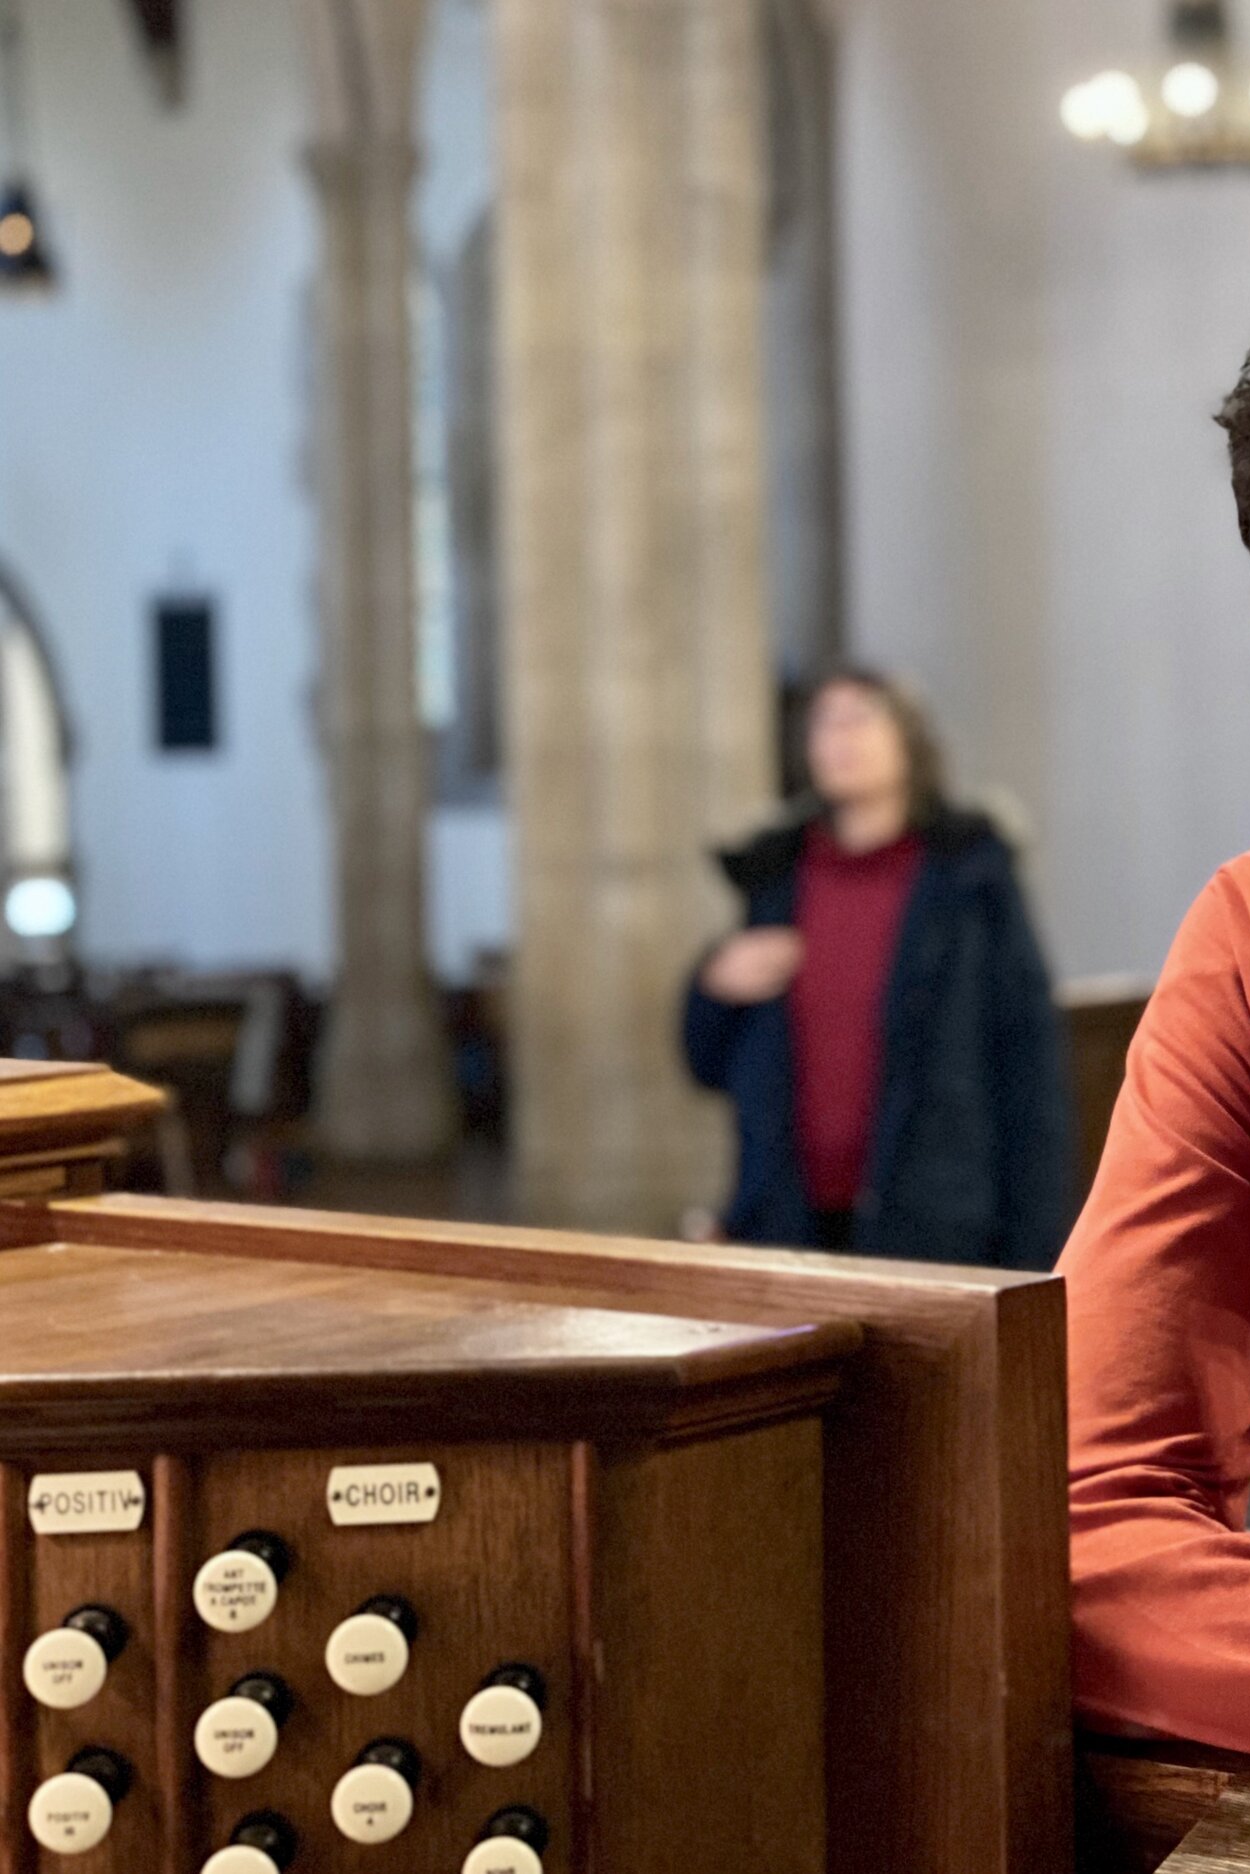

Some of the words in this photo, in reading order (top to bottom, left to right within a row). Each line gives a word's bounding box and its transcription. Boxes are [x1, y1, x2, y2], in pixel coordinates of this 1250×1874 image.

[345, 1482, 420, 1507] CHOIR
[38, 1489, 133, 1516] POSITIV
[344, 1652, 385, 1665] CHIMES
[42, 1660, 83, 1671] UNISON
[52, 1673, 73, 1685] OFF
[213, 1729, 255, 1739] UNISON
[468, 1722, 532, 1736] TREMULANT
[223, 1742, 244, 1754] OFF
[353, 1802, 387, 1813] CHOIR
[47, 1811, 90, 1822] POSITIV
